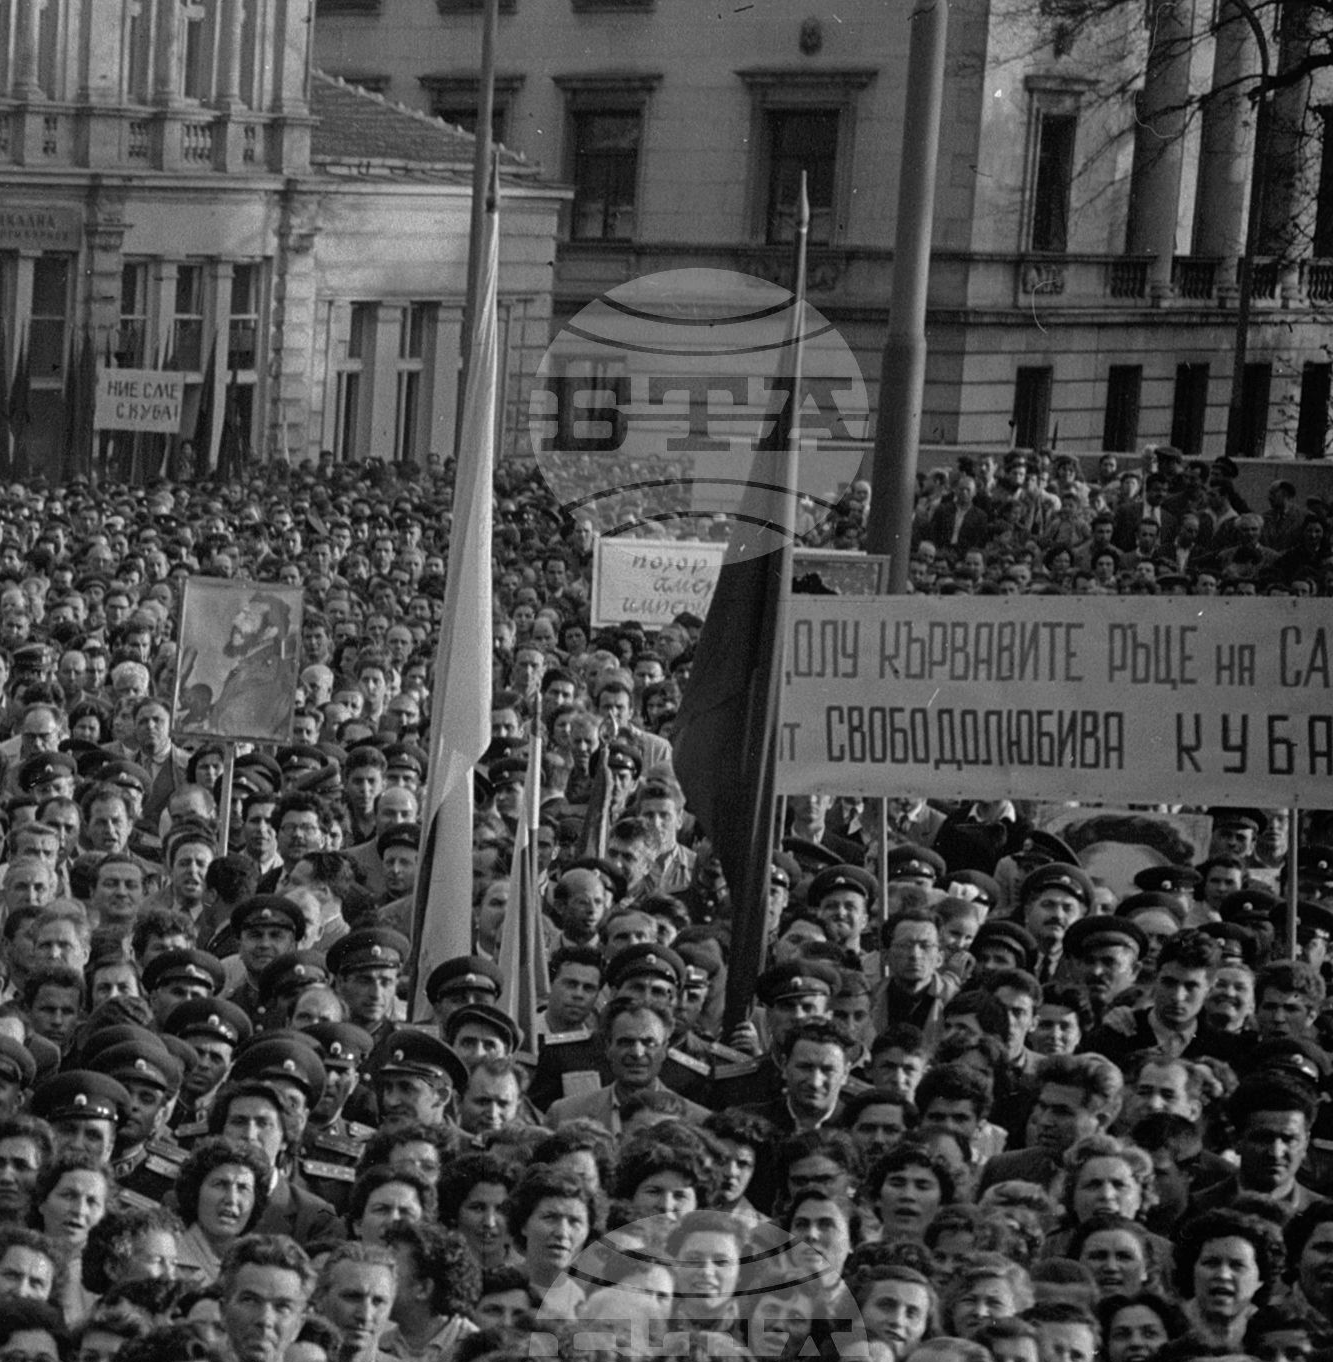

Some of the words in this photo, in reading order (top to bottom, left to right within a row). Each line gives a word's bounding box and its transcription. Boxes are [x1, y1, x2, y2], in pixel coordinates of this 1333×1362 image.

[107, 381, 138, 398] НИЕ
[143, 382, 179, 400] СМЕ
[116, 402, 124, 419] С
[654, 577, 712, 598] амер
[785, 620, 860, 685] ОЛУ
[879, 620, 1084, 682] КЪРВАВИТЕ
[1108, 622, 1198, 690] РЪЦЕ
[826, 706, 1124, 771] СВОБОДОЛЮБИВА
[1176, 713, 1333, 776] КУБА
